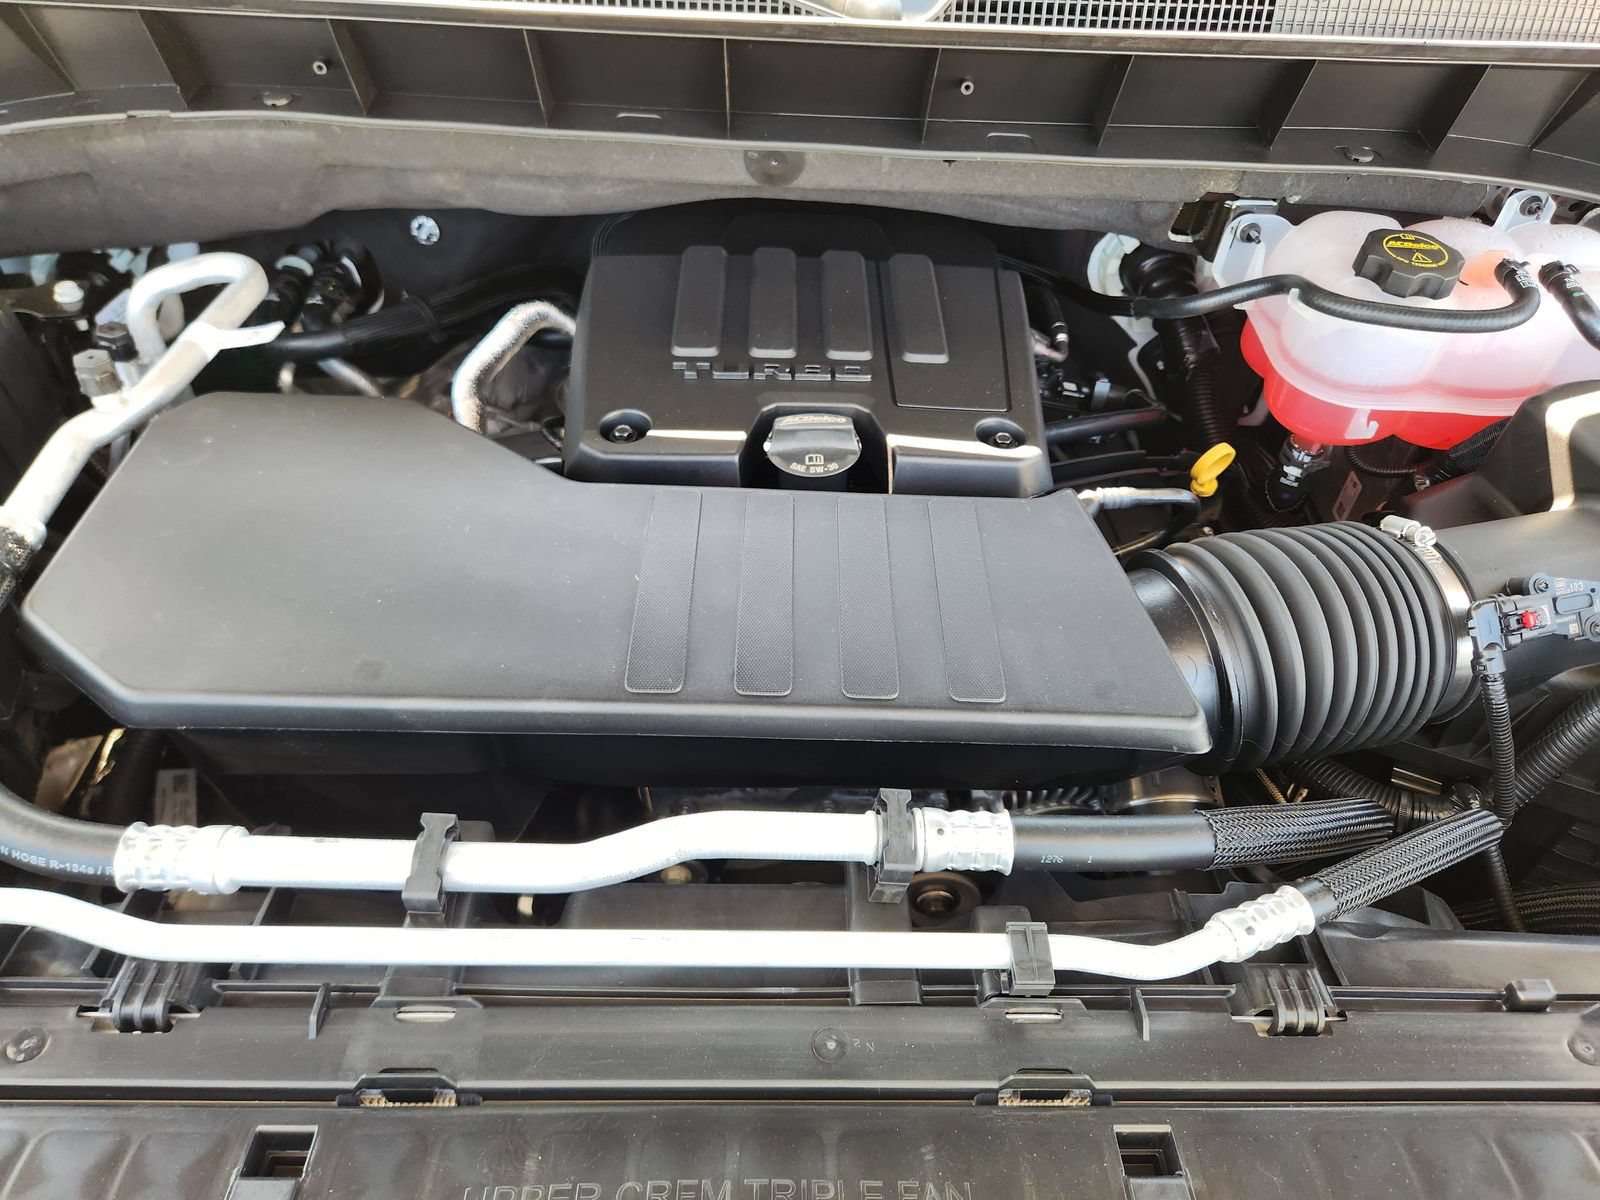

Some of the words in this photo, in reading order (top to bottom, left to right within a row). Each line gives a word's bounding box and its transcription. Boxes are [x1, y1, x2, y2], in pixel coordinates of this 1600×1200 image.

[1386, 240, 1440, 250] ACDelco
[672, 361, 873, 382] TURBO
[780, 415, 847, 425] ACDelco
[789, 462, 807, 472] SAE
[809, 462, 840, 473] 5W-30
[11, 850, 47, 867] HOSE
[49, 859, 95, 875] R-134a
[1040, 854, 1064, 864] 1276
[897, 1180, 972, 1200] FAN
